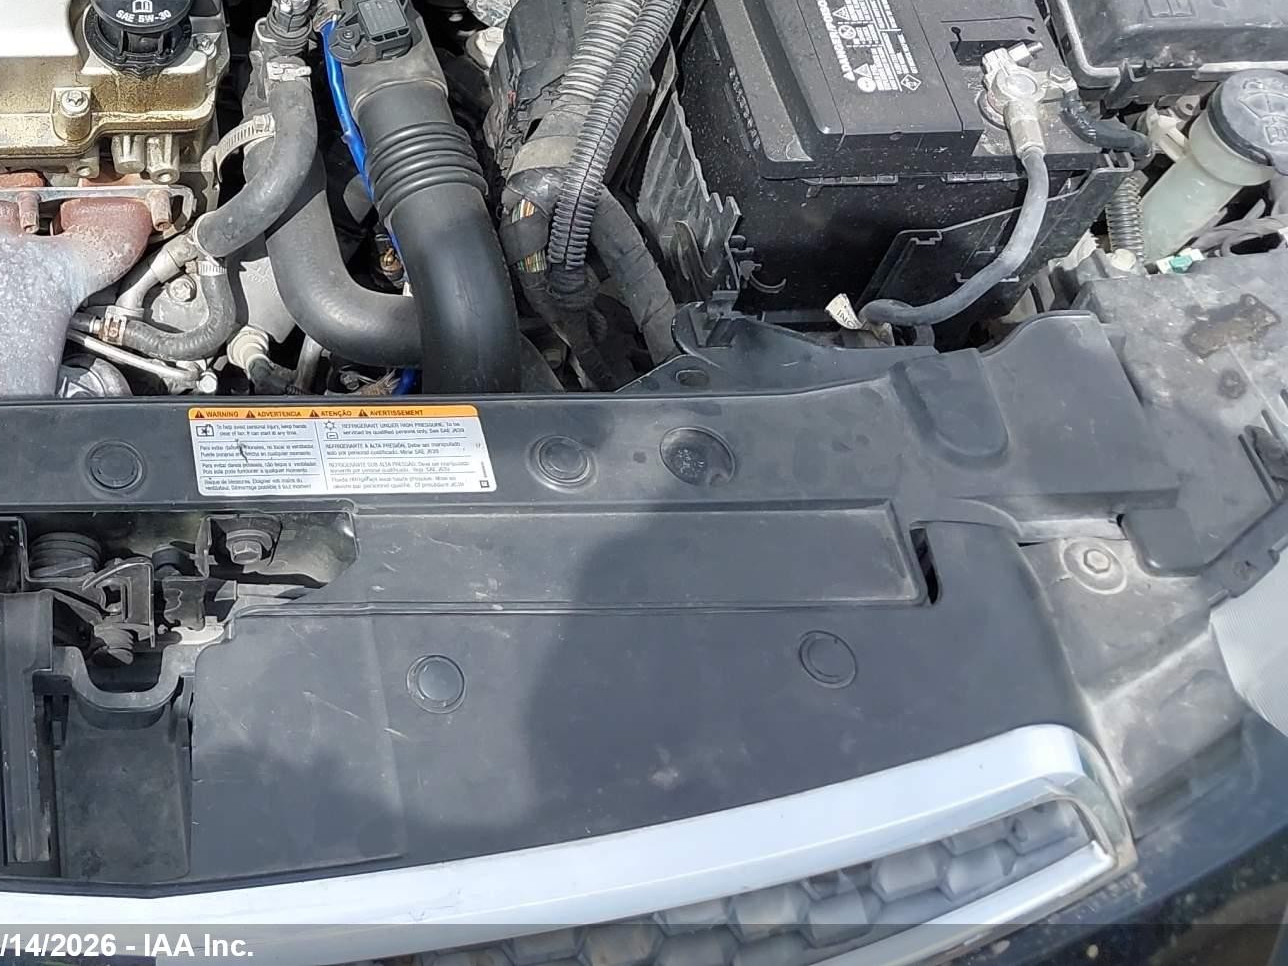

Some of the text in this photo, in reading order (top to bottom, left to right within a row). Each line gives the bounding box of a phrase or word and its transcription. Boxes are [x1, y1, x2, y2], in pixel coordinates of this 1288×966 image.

[116, 10, 171, 23] SAE 5W-30
[321, 409, 352, 417] ATENÇÃO
